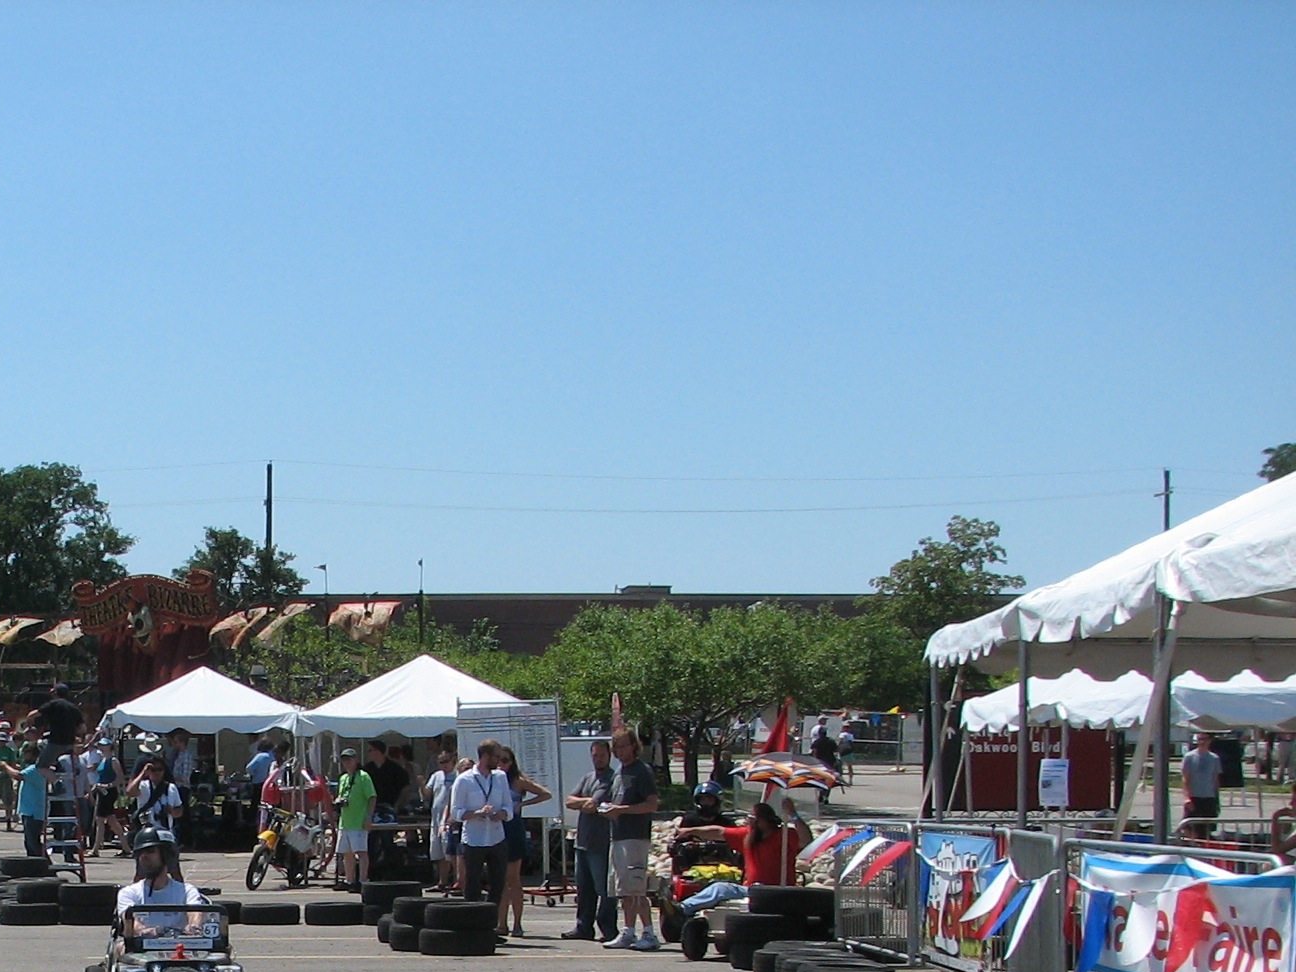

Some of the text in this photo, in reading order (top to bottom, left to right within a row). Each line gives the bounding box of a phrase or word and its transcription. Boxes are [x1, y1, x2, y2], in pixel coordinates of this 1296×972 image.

[146, 582, 212, 618] BIZARRE
[968, 740, 1062, 753] Oakwoo Blvd
[204, 925, 219, 936] 67
